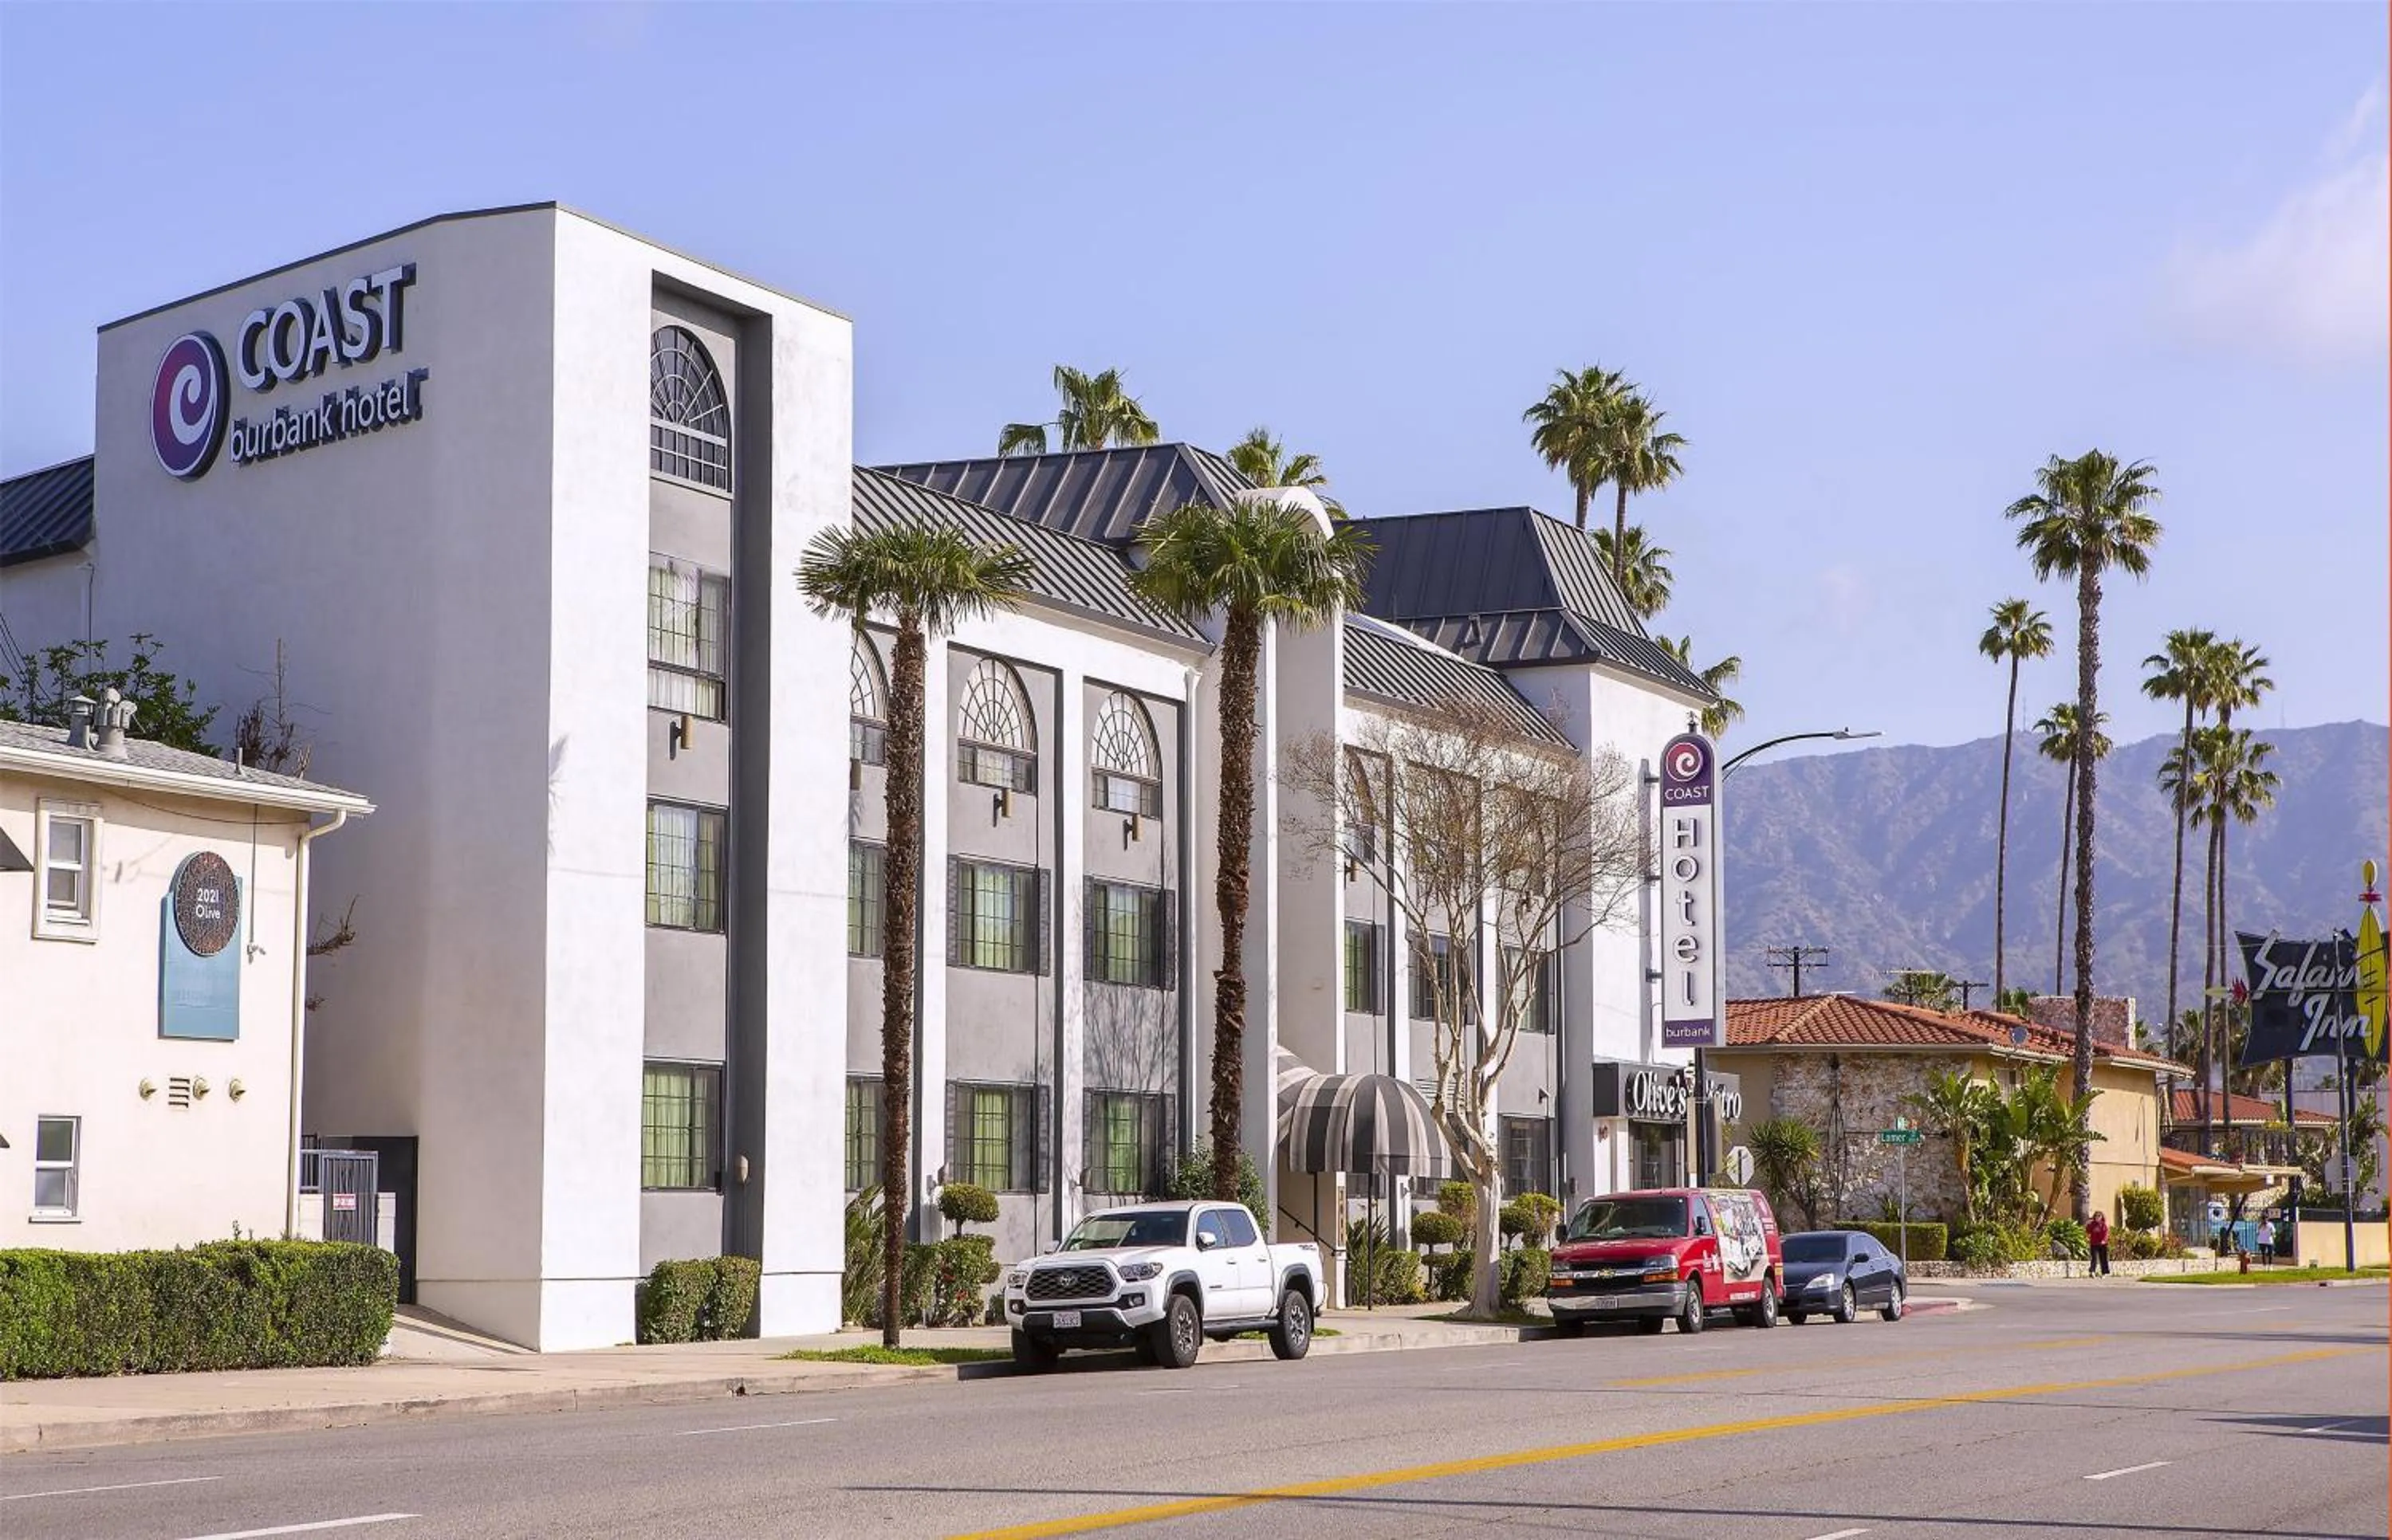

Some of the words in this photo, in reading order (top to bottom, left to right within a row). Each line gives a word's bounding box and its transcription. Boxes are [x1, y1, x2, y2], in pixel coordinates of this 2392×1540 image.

[237, 265, 405, 389] COAST
[230, 392, 332, 462] burbank
[341, 371, 410, 433] hotel
[1664, 785, 1709, 800] COAST
[195, 904, 221, 919] Olive
[197, 887, 219, 902] 2021
[1672, 818, 1699, 1007] Hotel
[2252, 929, 2363, 1008] Safari
[1666, 1026, 1710, 1038] burbank
[2299, 993, 2372, 1051] Inn
[1634, 1071, 1686, 1114] Olive's
